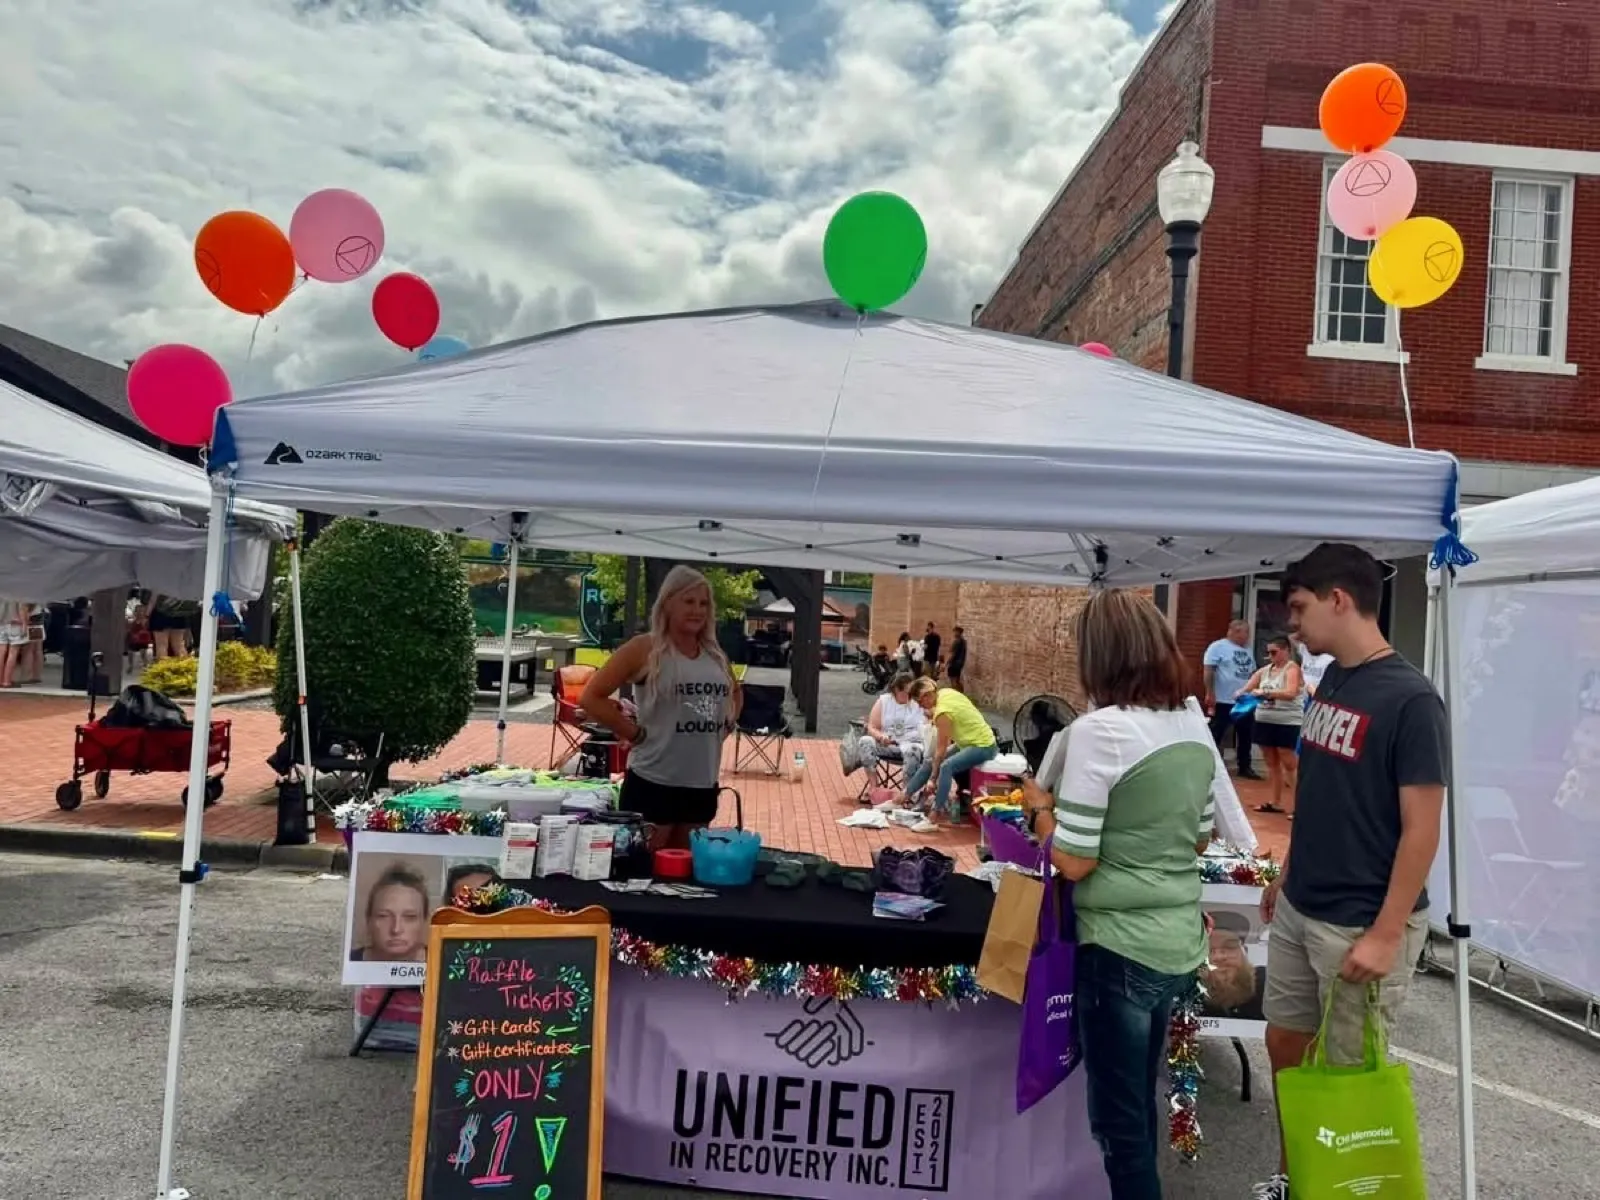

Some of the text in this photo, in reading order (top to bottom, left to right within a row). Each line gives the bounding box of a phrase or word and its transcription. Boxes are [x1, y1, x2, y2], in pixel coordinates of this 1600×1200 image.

[1300, 700, 1361, 758] ARVEL
[390, 966, 426, 977] #GAR
[467, 957, 536, 983] Raffle
[498, 984, 575, 1010] Tickets
[464, 1018, 499, 1036] Gift
[462, 1042, 493, 1060] Gift
[474, 1060, 545, 1100] ONLY
[672, 1069, 896, 1149] UNIFIED
[928, 1096, 943, 1185] 2021
[669, 1140, 896, 1188] IN RECOVERY INC.
